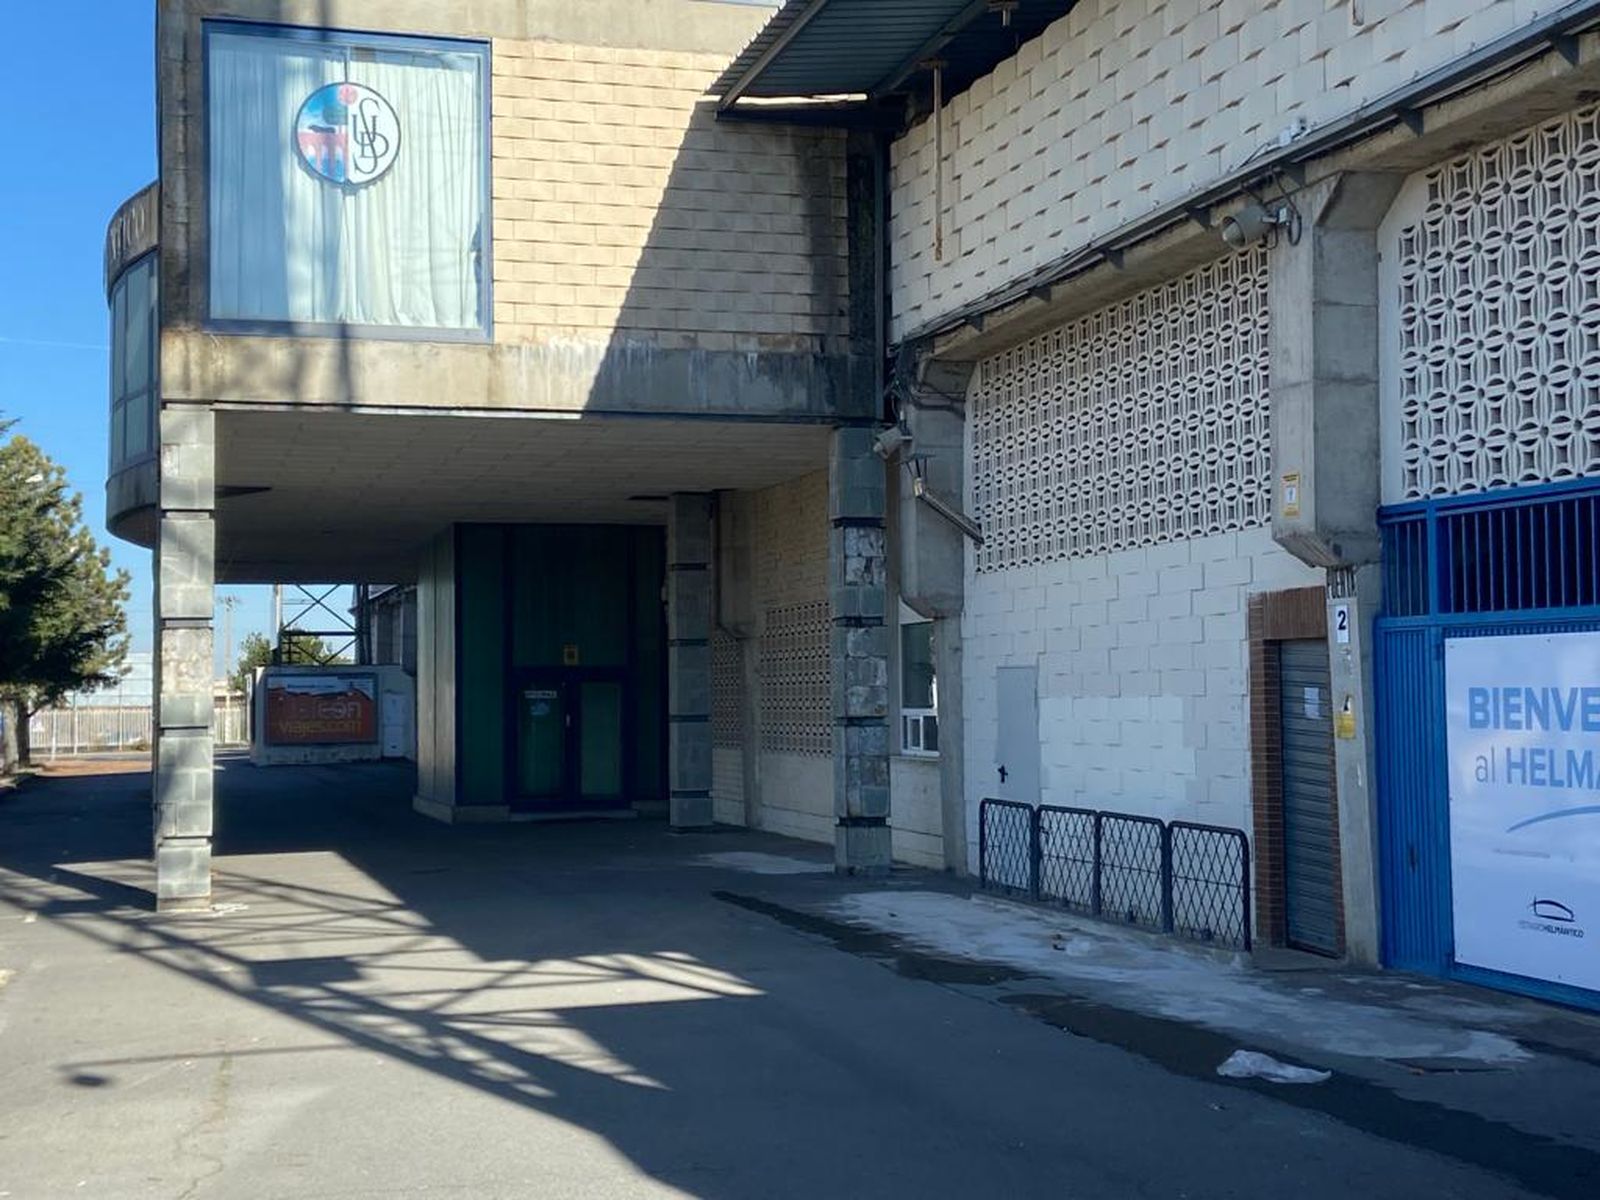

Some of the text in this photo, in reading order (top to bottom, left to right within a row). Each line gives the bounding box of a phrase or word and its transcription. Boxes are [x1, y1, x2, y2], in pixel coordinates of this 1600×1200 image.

[1337, 609, 1347, 631] 2
[1474, 745, 1600, 790] al HELM
